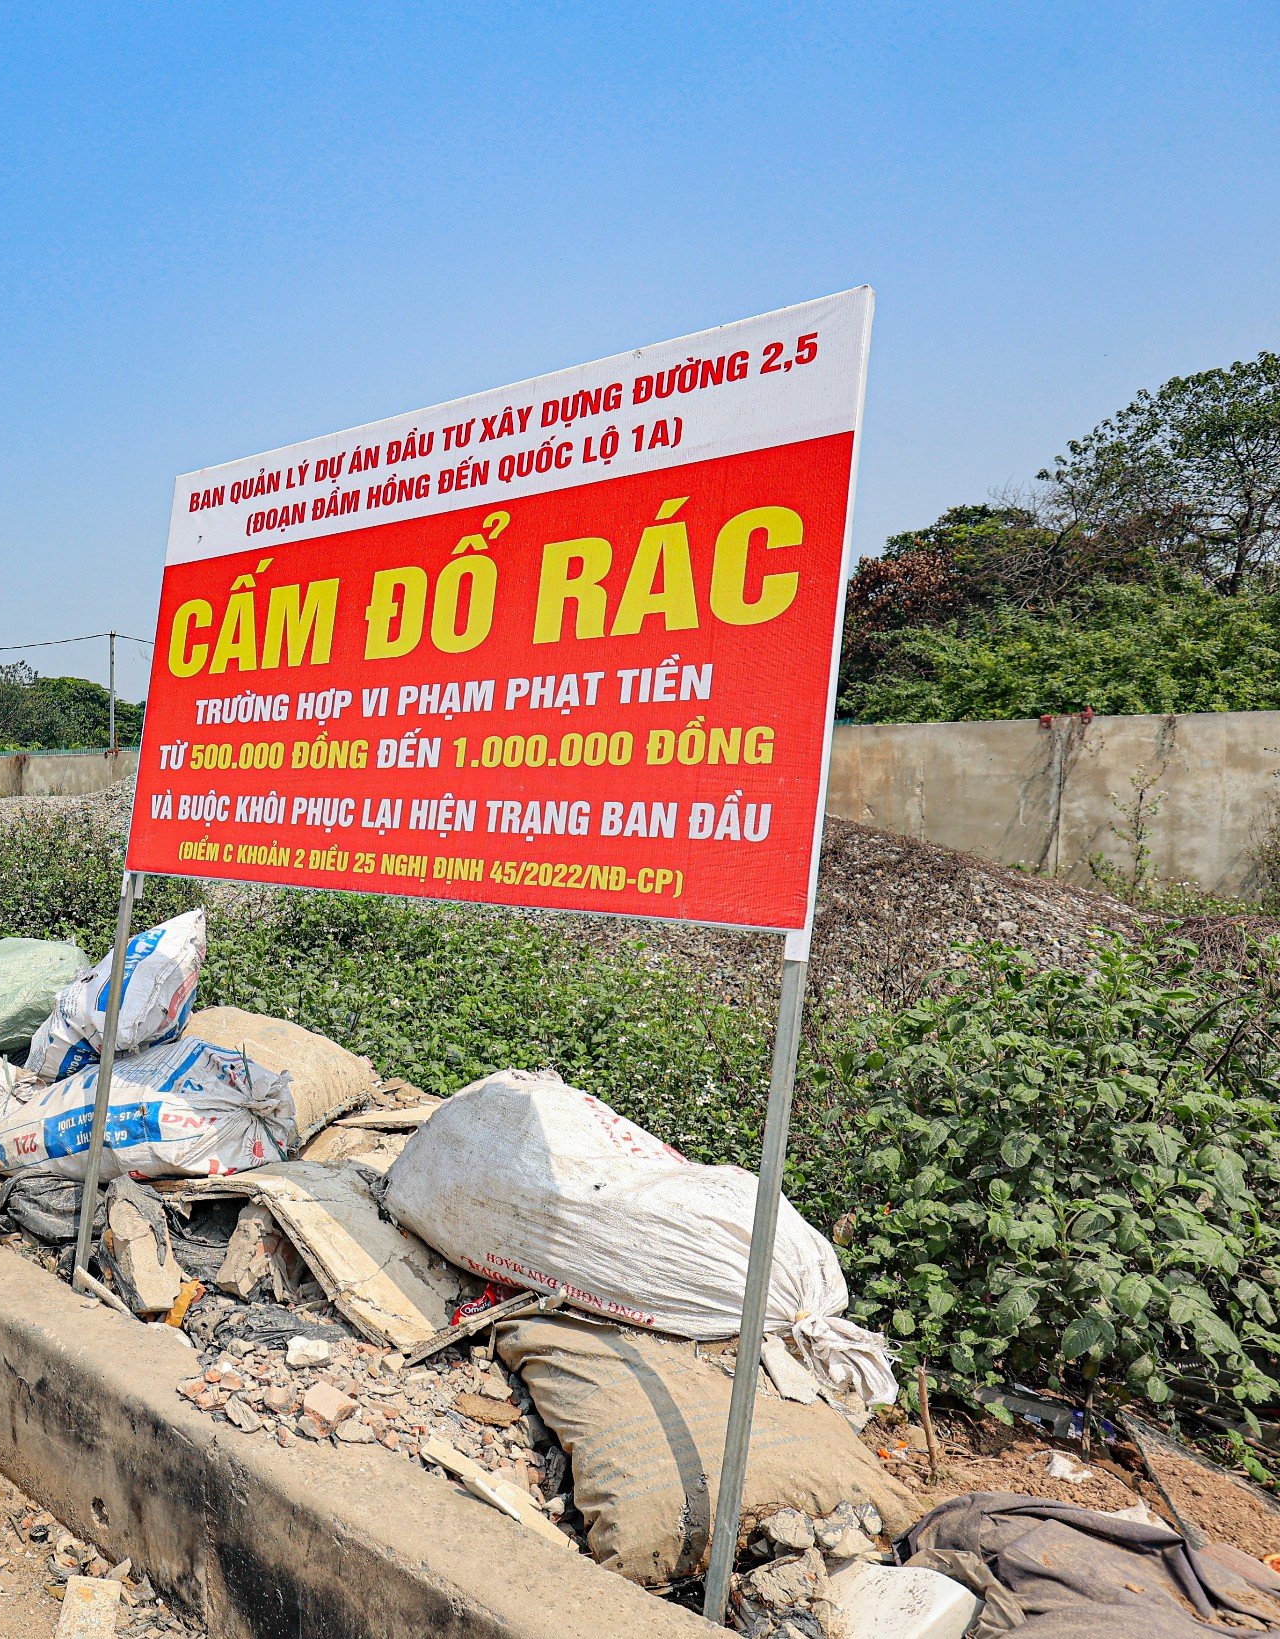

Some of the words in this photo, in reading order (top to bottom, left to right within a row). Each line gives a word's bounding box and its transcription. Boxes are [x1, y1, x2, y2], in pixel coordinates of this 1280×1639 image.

[190, 486, 225, 512] BAN
[230, 472, 280, 503] QUẢN
[286, 464, 309, 489] LÝ
[315, 454, 345, 485] DỰ
[349, 446, 380, 473] ÁN
[387, 432, 434, 465] ĐẦU
[443, 419, 475, 451] TƯ
[480, 406, 532, 442] XÂY
[541, 383, 622, 427] DỰNG
[633, 351, 749, 404] ĐƯỜNG
[761, 333, 818, 374] 2,5
[247, 502, 306, 536] (ĐOẠN
[312, 486, 360, 520] ĐẦM
[367, 474, 430, 509] HỒNG
[438, 460, 490, 494] ĐẾN
[498, 441, 573, 483] QUỐC
[583, 426, 619, 464] LỘ
[633, 417, 682, 452] 1A)
[169, 558, 339, 677] CẤM
[365, 511, 510, 660] ĐỔ
[533, 496, 803, 644] RÁC
[196, 690, 289, 724] TRƯỜNG
[296, 688, 352, 725] HỢP
[362, 688, 389, 717] VI
[397, 680, 495, 720] PHẠM
[505, 672, 604, 714] PHẠT
[617, 654, 713, 703] TIỀN
[160, 740, 188, 770] TỪ
[190, 742, 284, 769] 500.000
[291, 731, 368, 769] ĐỒNG
[377, 728, 441, 768] ĐẾN
[453, 731, 633, 768] 1.000.000
[646, 716, 774, 765] ĐỒNG
[152, 790, 172, 819] VÀ
[178, 790, 230, 827] BUỘC
[235, 791, 286, 824] KHÔI
[291, 797, 355, 833] PHỤC
[362, 799, 402, 835] LẠI
[409, 793, 476, 831] HIỆN
[486, 801, 590, 841] TRẠNG
[600, 802, 677, 838] BAN
[688, 790, 771, 842] ĐẦU
[179, 835, 219, 861] (ĐIỂM
[223, 844, 233, 862] C
[237, 840, 290, 867] KHOẢN
[294, 849, 305, 868] 2
[309, 844, 349, 871] ĐIỀU
[353, 853, 376, 873] 25
[381, 854, 428, 882] NGHỊ
[433, 857, 484, 884] ĐỊNH
[490, 861, 683, 898] 45/2022/NĐ-CP)
[119, 1112, 131, 1121] 15
[14, 1133, 37, 1156] 221
[485, 1252, 525, 1275] MẠCH
[528, 1268, 558, 1289] ĐAN
